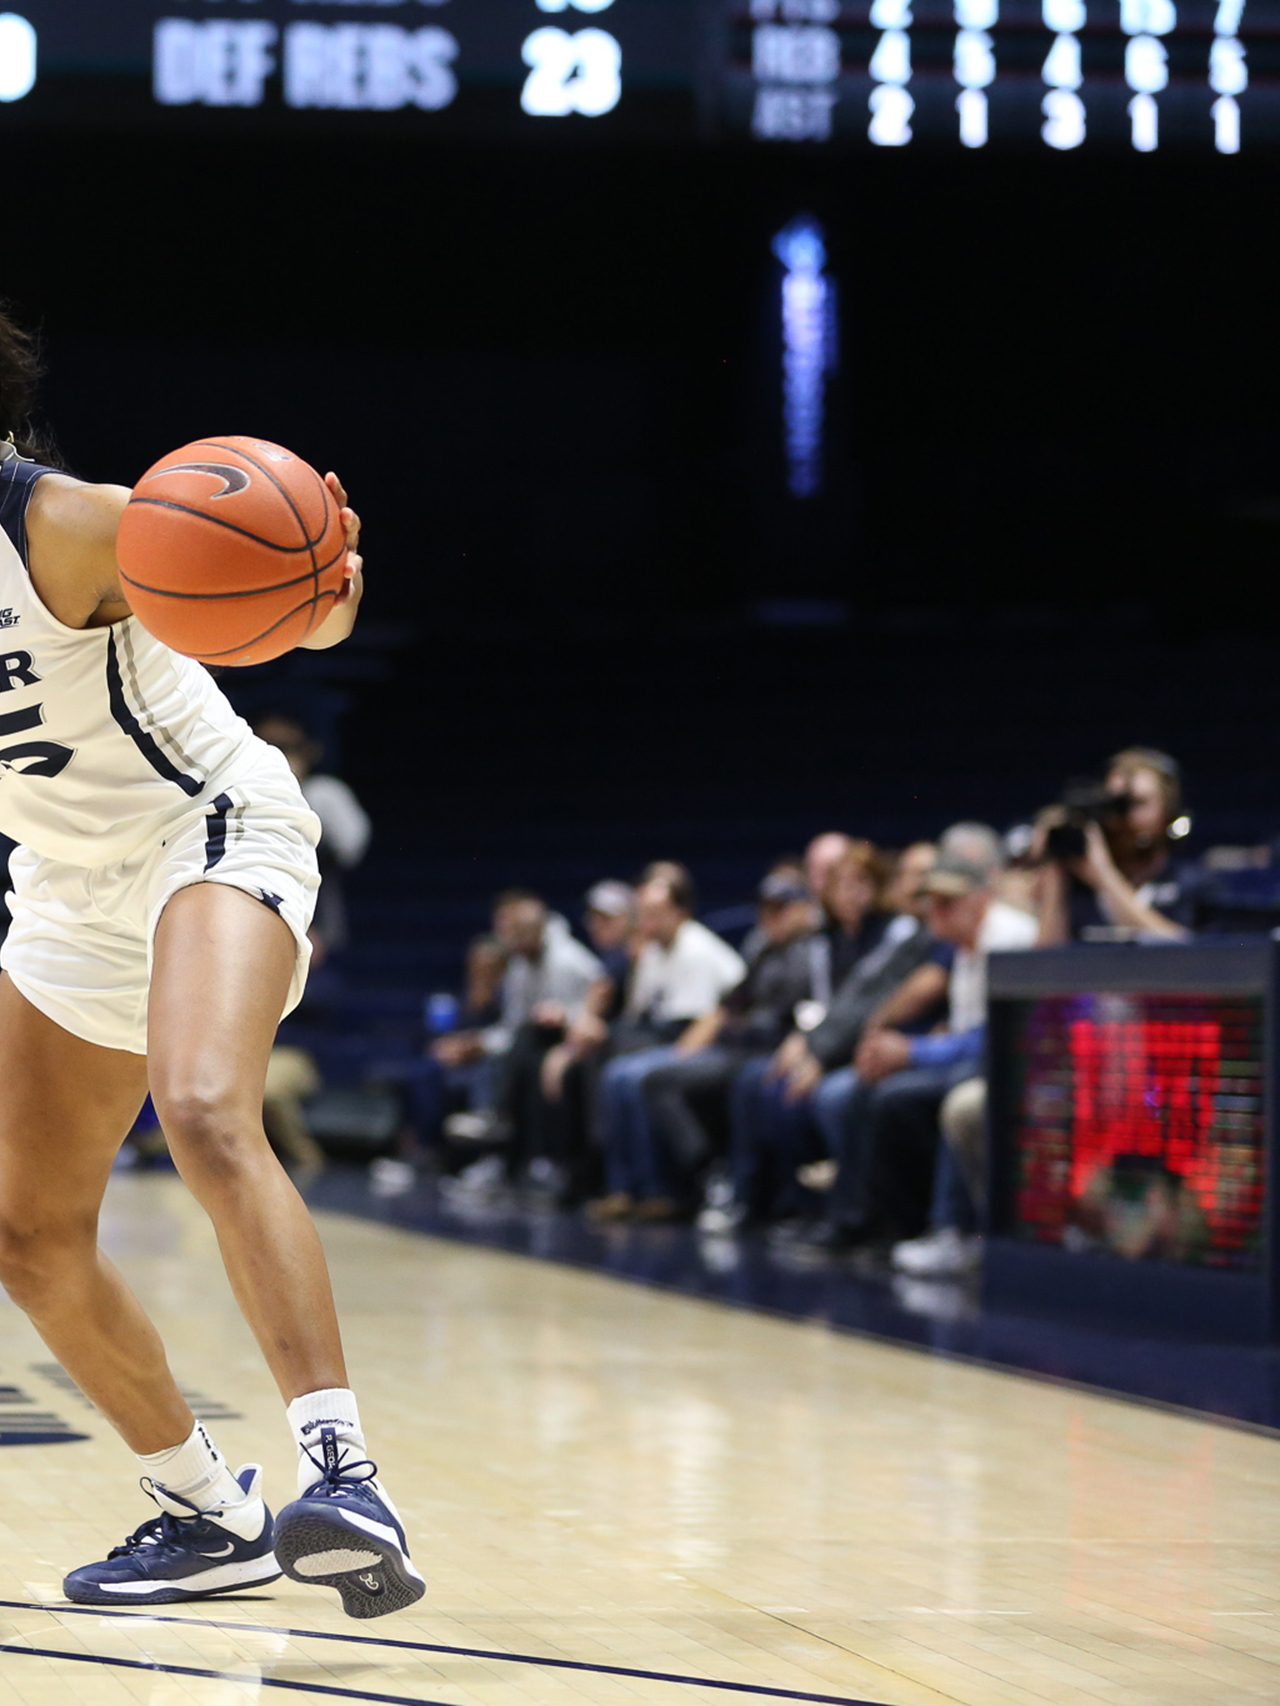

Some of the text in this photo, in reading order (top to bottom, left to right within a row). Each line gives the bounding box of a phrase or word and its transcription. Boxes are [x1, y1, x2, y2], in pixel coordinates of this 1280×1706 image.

[153, 18, 622, 117] DEF REBS 23
